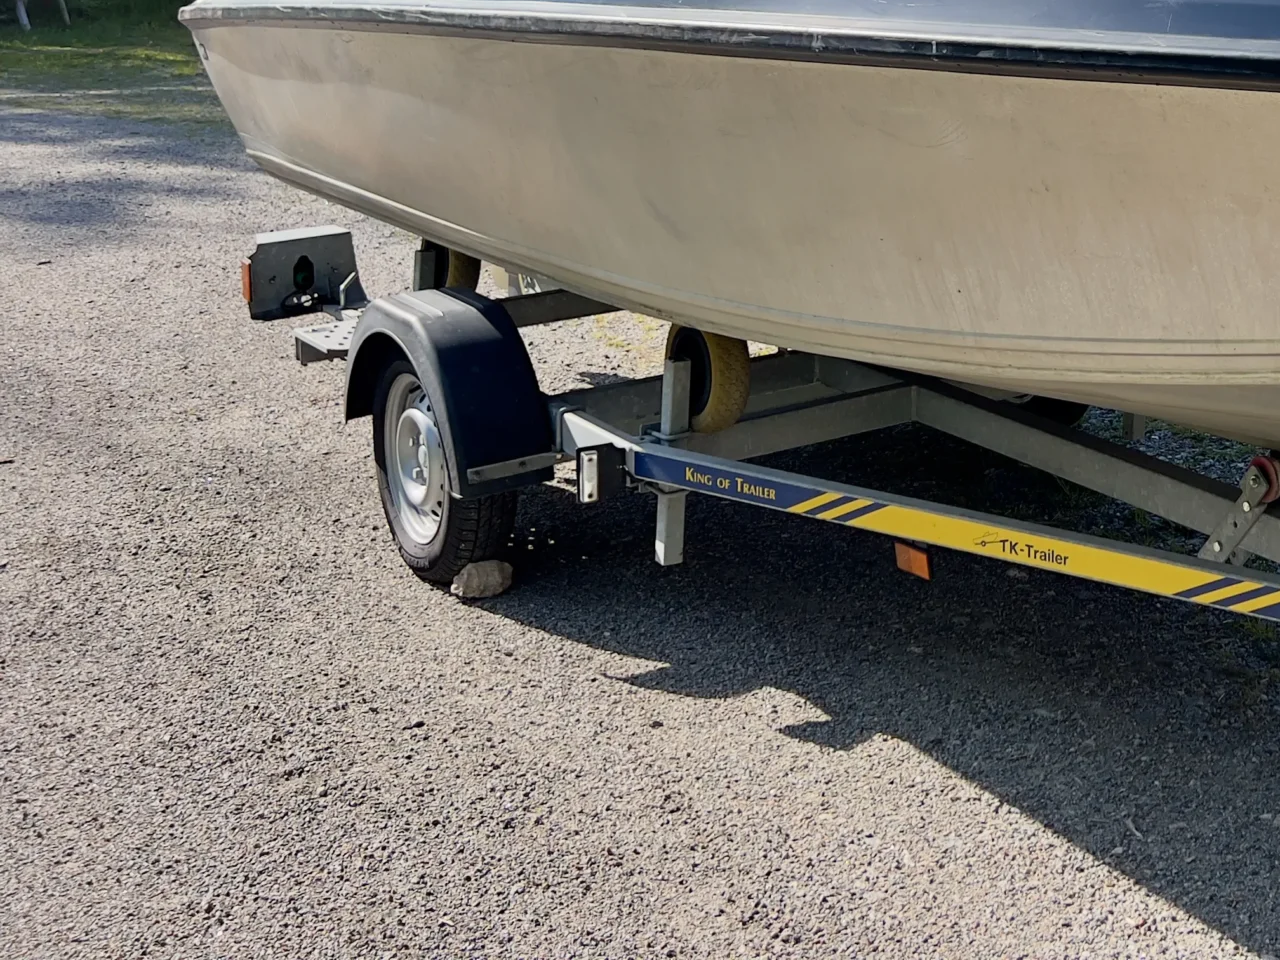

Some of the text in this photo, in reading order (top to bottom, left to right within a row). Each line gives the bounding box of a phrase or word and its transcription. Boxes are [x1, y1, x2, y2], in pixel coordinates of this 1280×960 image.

[685, 467, 776, 500] KING OF TRAILER
[1000, 539, 1069, 565] TK-Trailer
